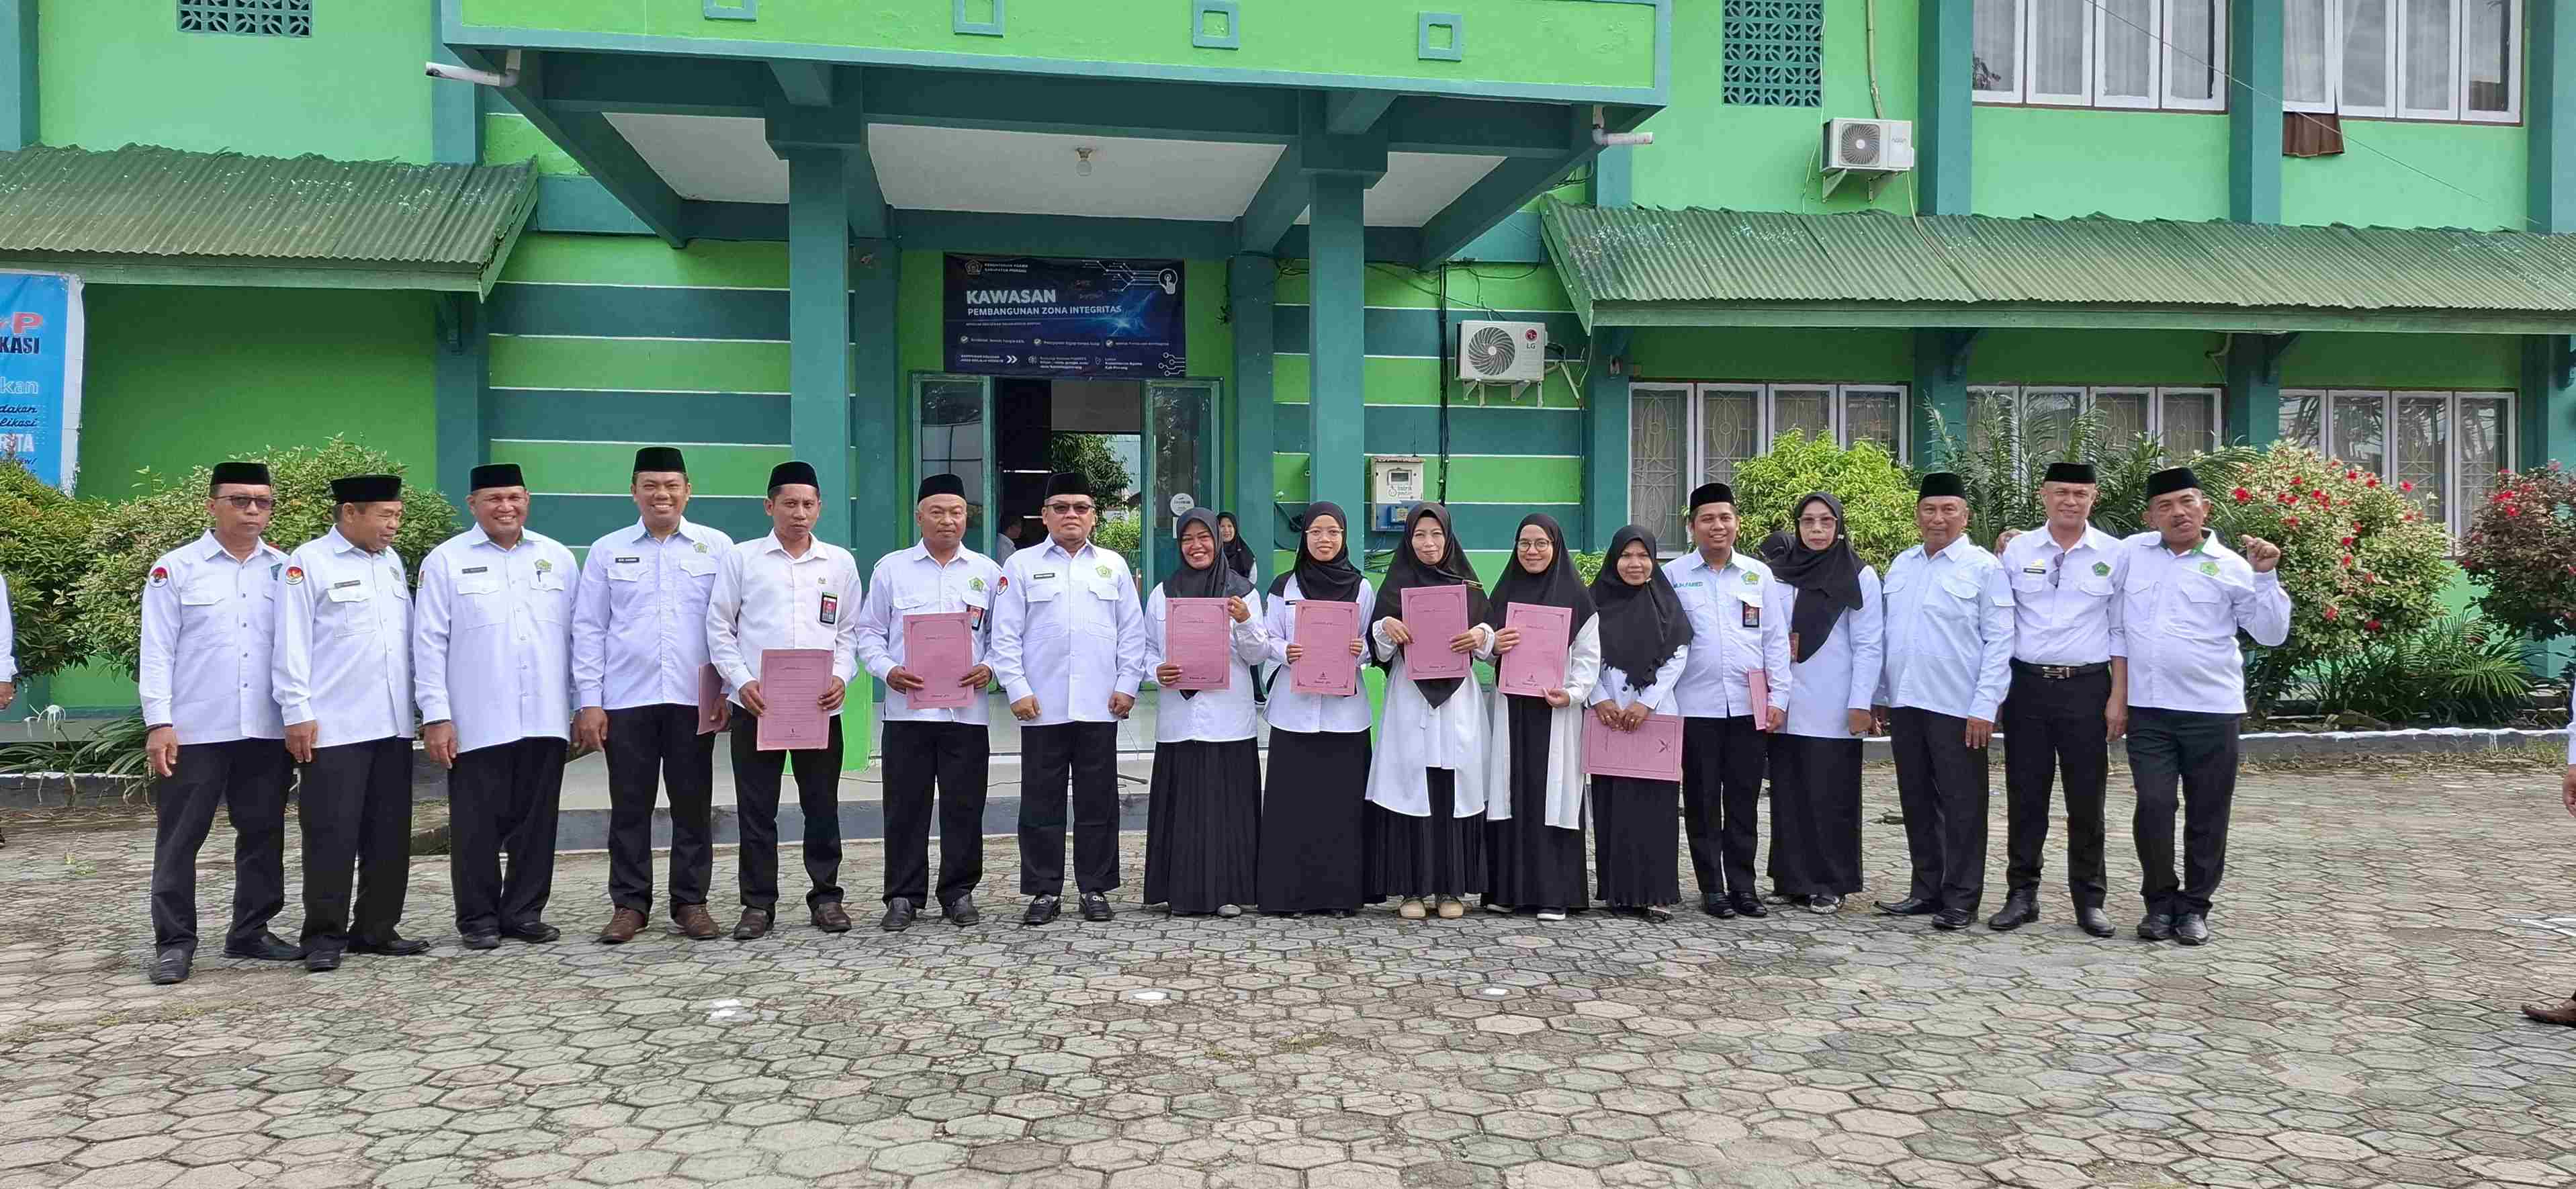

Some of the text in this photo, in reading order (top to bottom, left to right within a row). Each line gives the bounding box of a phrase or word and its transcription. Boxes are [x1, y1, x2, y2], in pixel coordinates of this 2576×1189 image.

[966, 289, 1057, 304] KAWASAN
[967, 305, 1122, 316] PEMBANGUNAN ZONA INTEGRITAS
[0, 376, 39, 394] kan
